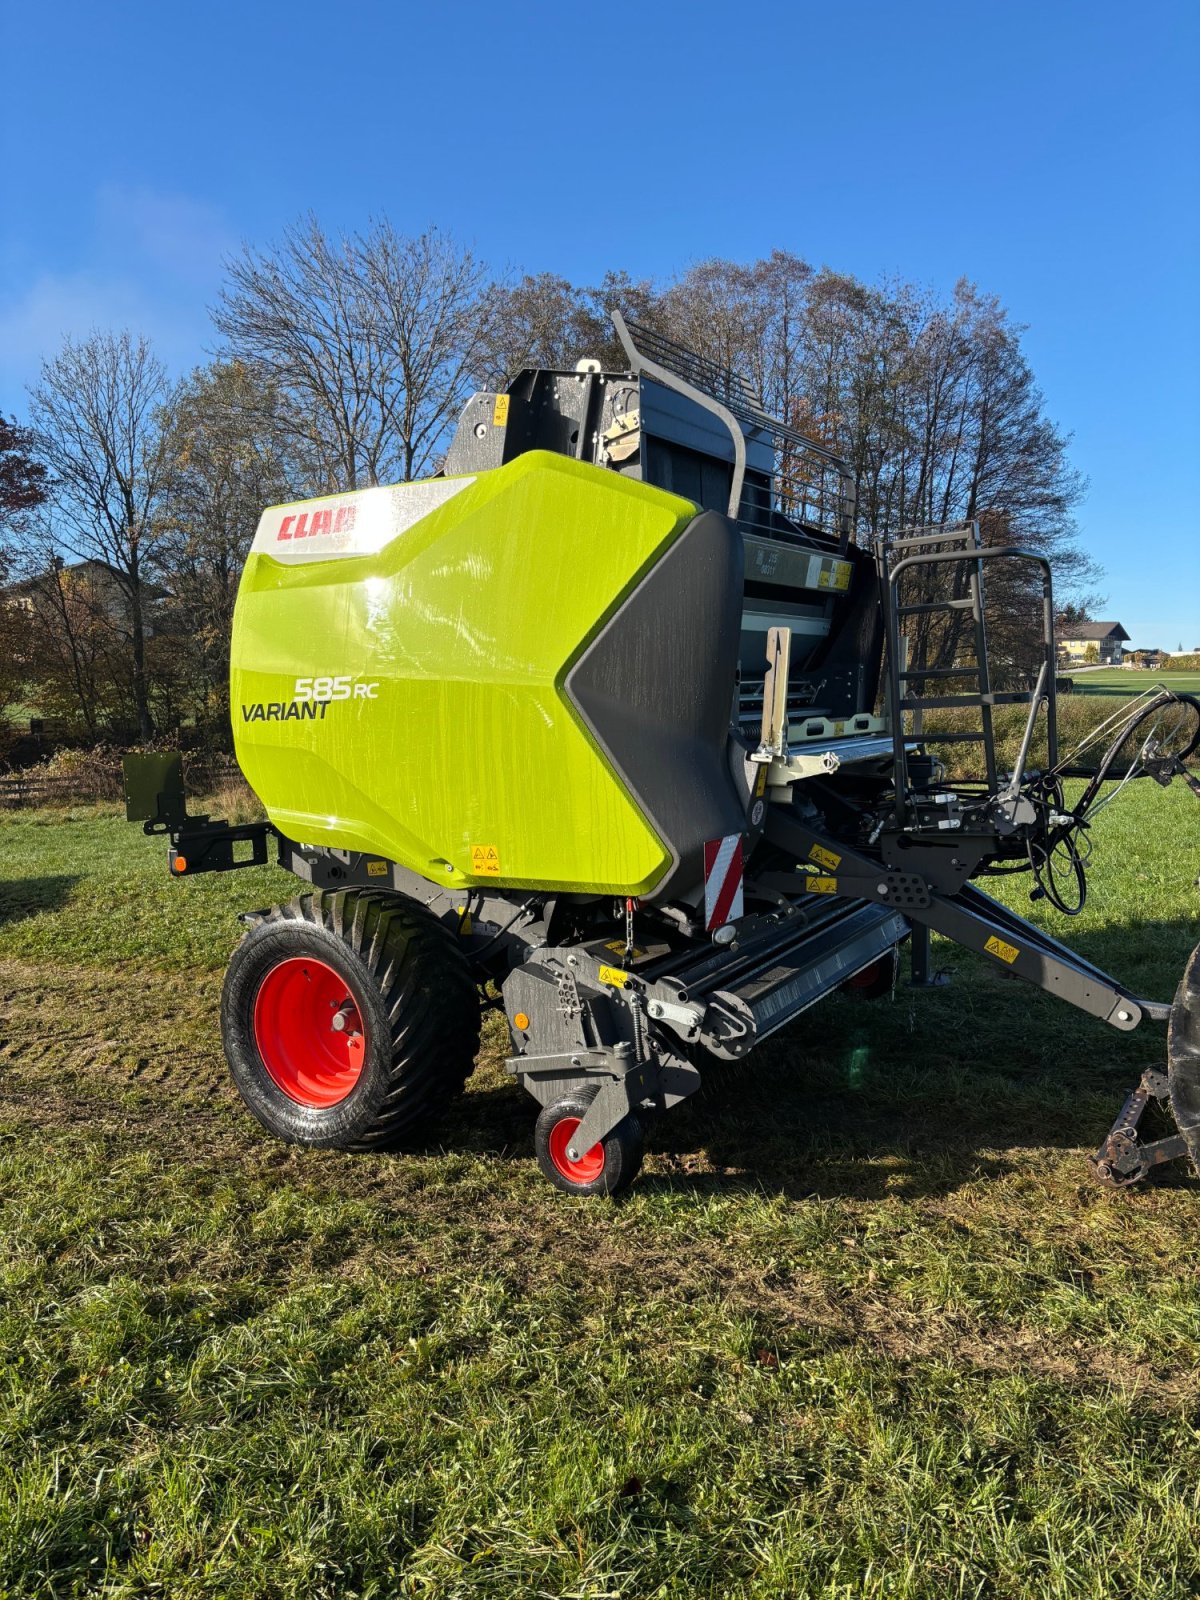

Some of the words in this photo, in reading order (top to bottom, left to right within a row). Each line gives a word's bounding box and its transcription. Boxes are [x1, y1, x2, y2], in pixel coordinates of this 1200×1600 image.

[293, 675, 352, 702] 585
[353, 683, 380, 699] RC
[242, 700, 331, 722] VARIANT
